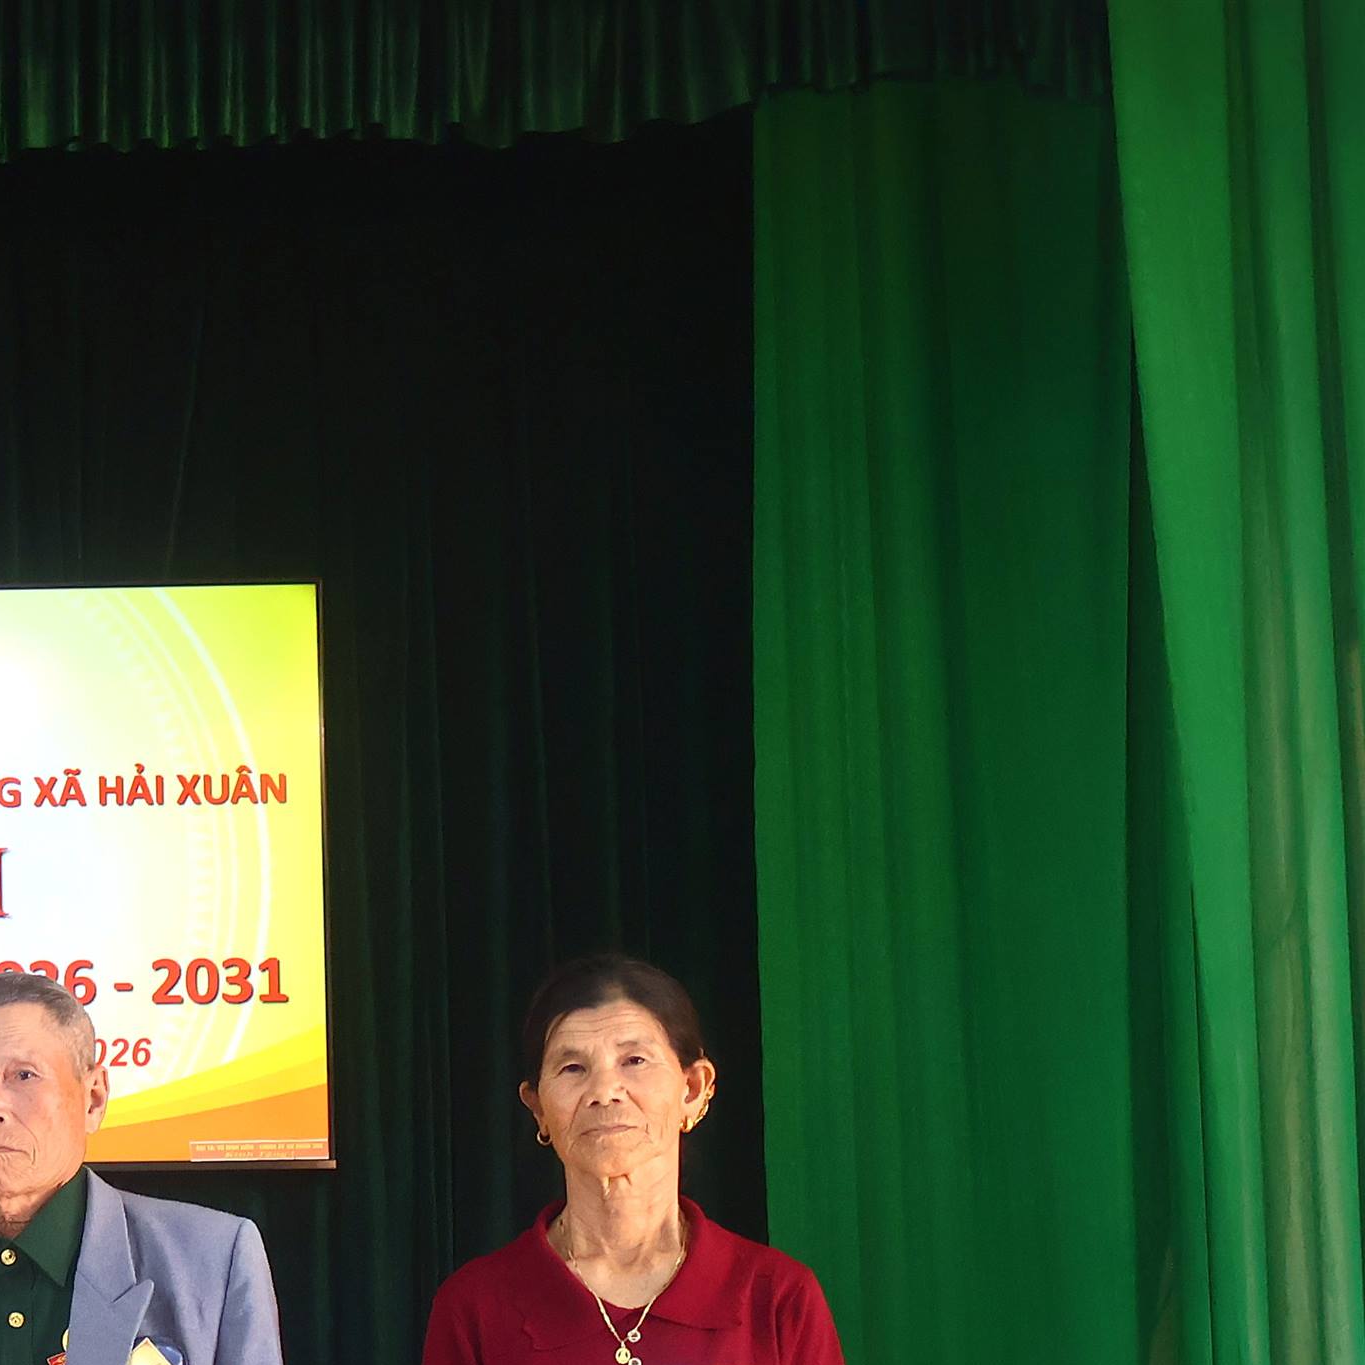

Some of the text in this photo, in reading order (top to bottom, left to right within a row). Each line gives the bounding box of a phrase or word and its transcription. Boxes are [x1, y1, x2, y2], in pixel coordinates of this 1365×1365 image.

[34, 768, 87, 807] XÃ
[98, 763, 165, 806] HẢI
[176, 765, 288, 805] XUÂN
[151, 957, 290, 1006] 2031
[95, 1037, 153, 1068] 026
